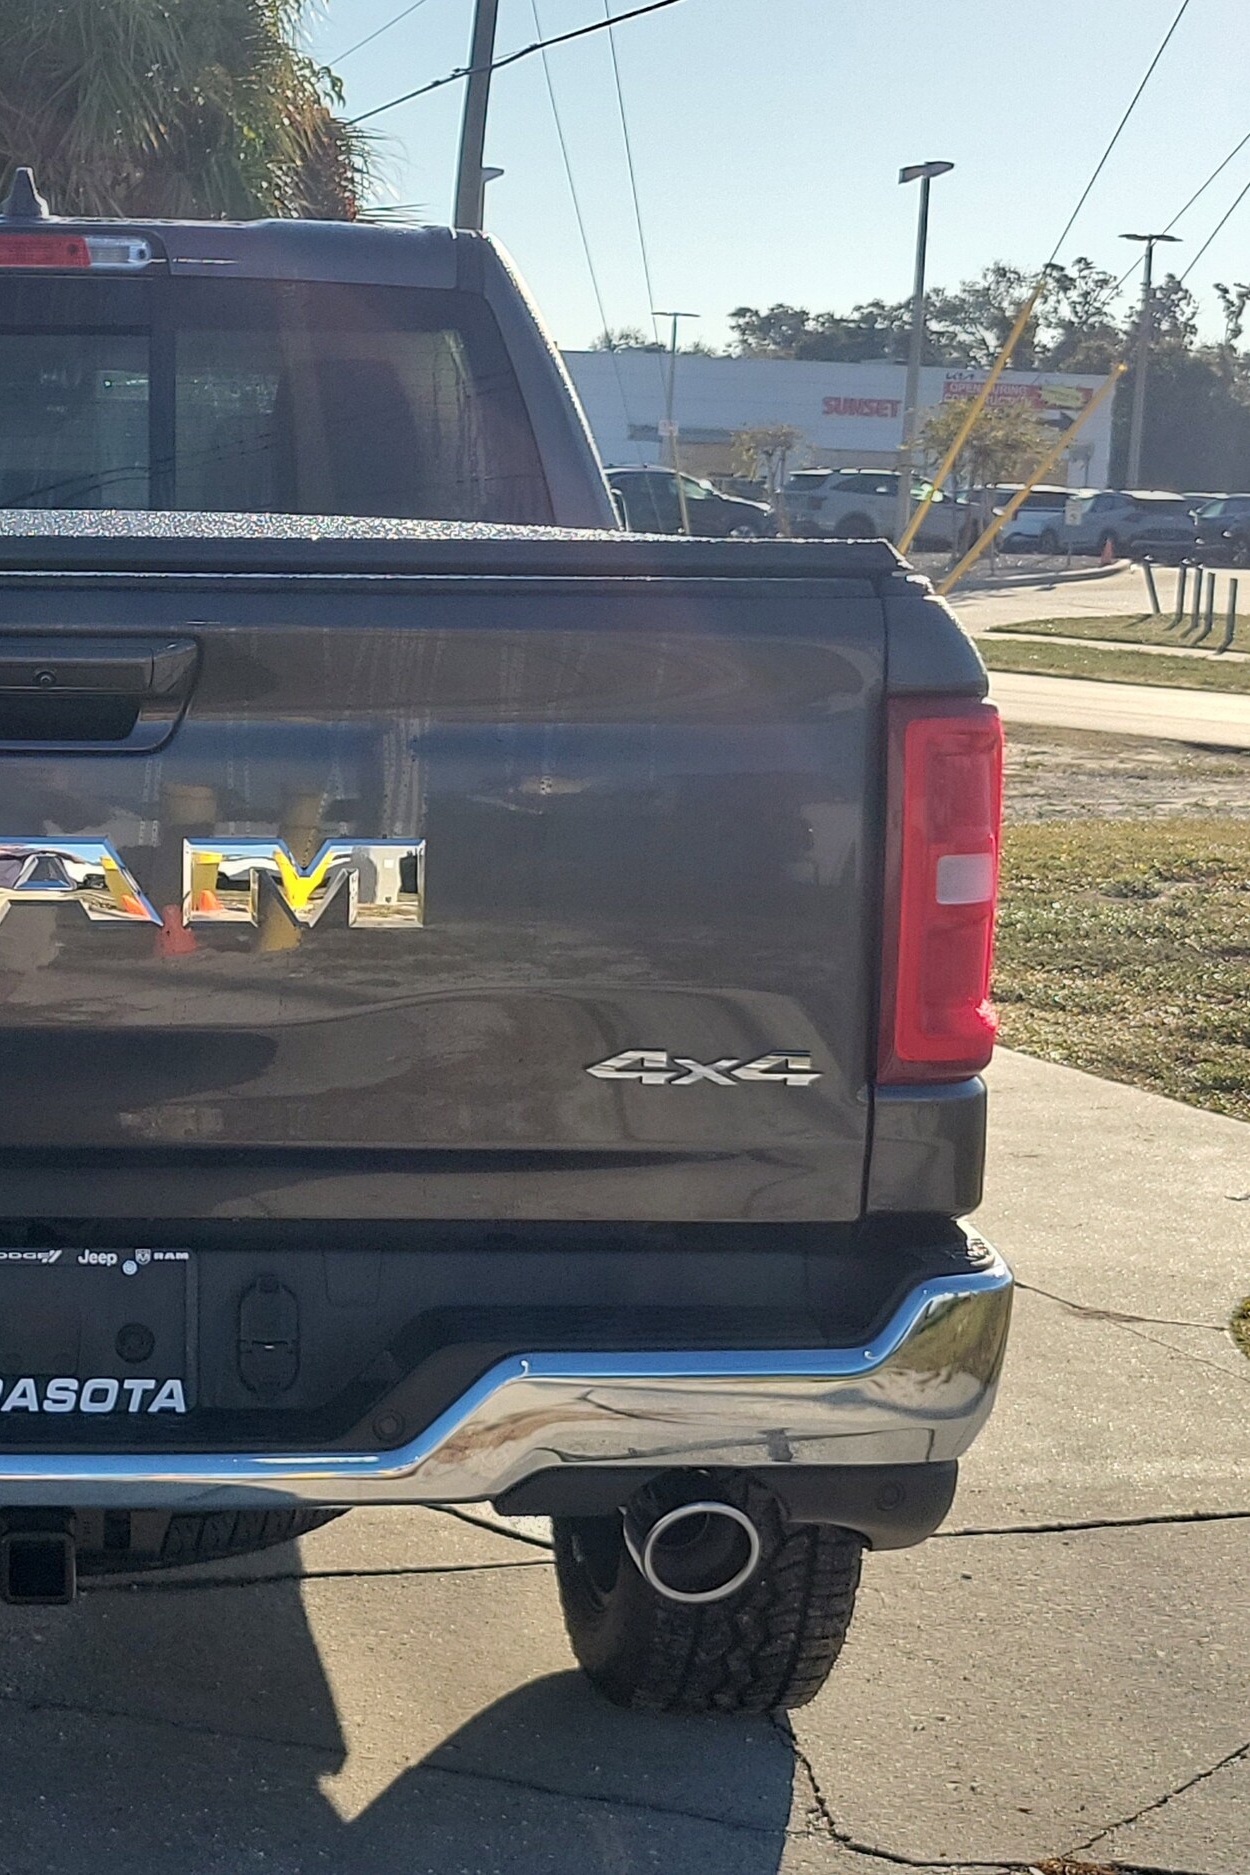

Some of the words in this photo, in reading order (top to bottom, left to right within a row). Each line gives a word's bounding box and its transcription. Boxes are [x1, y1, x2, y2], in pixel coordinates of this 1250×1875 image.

[949, 382, 981, 394] OPEN
[986, 384, 1028, 395] URING
[822, 397, 902, 418] SUNSET
[77, 1249, 118, 1266] Jeep
[153, 1252, 190, 1261] RAM
